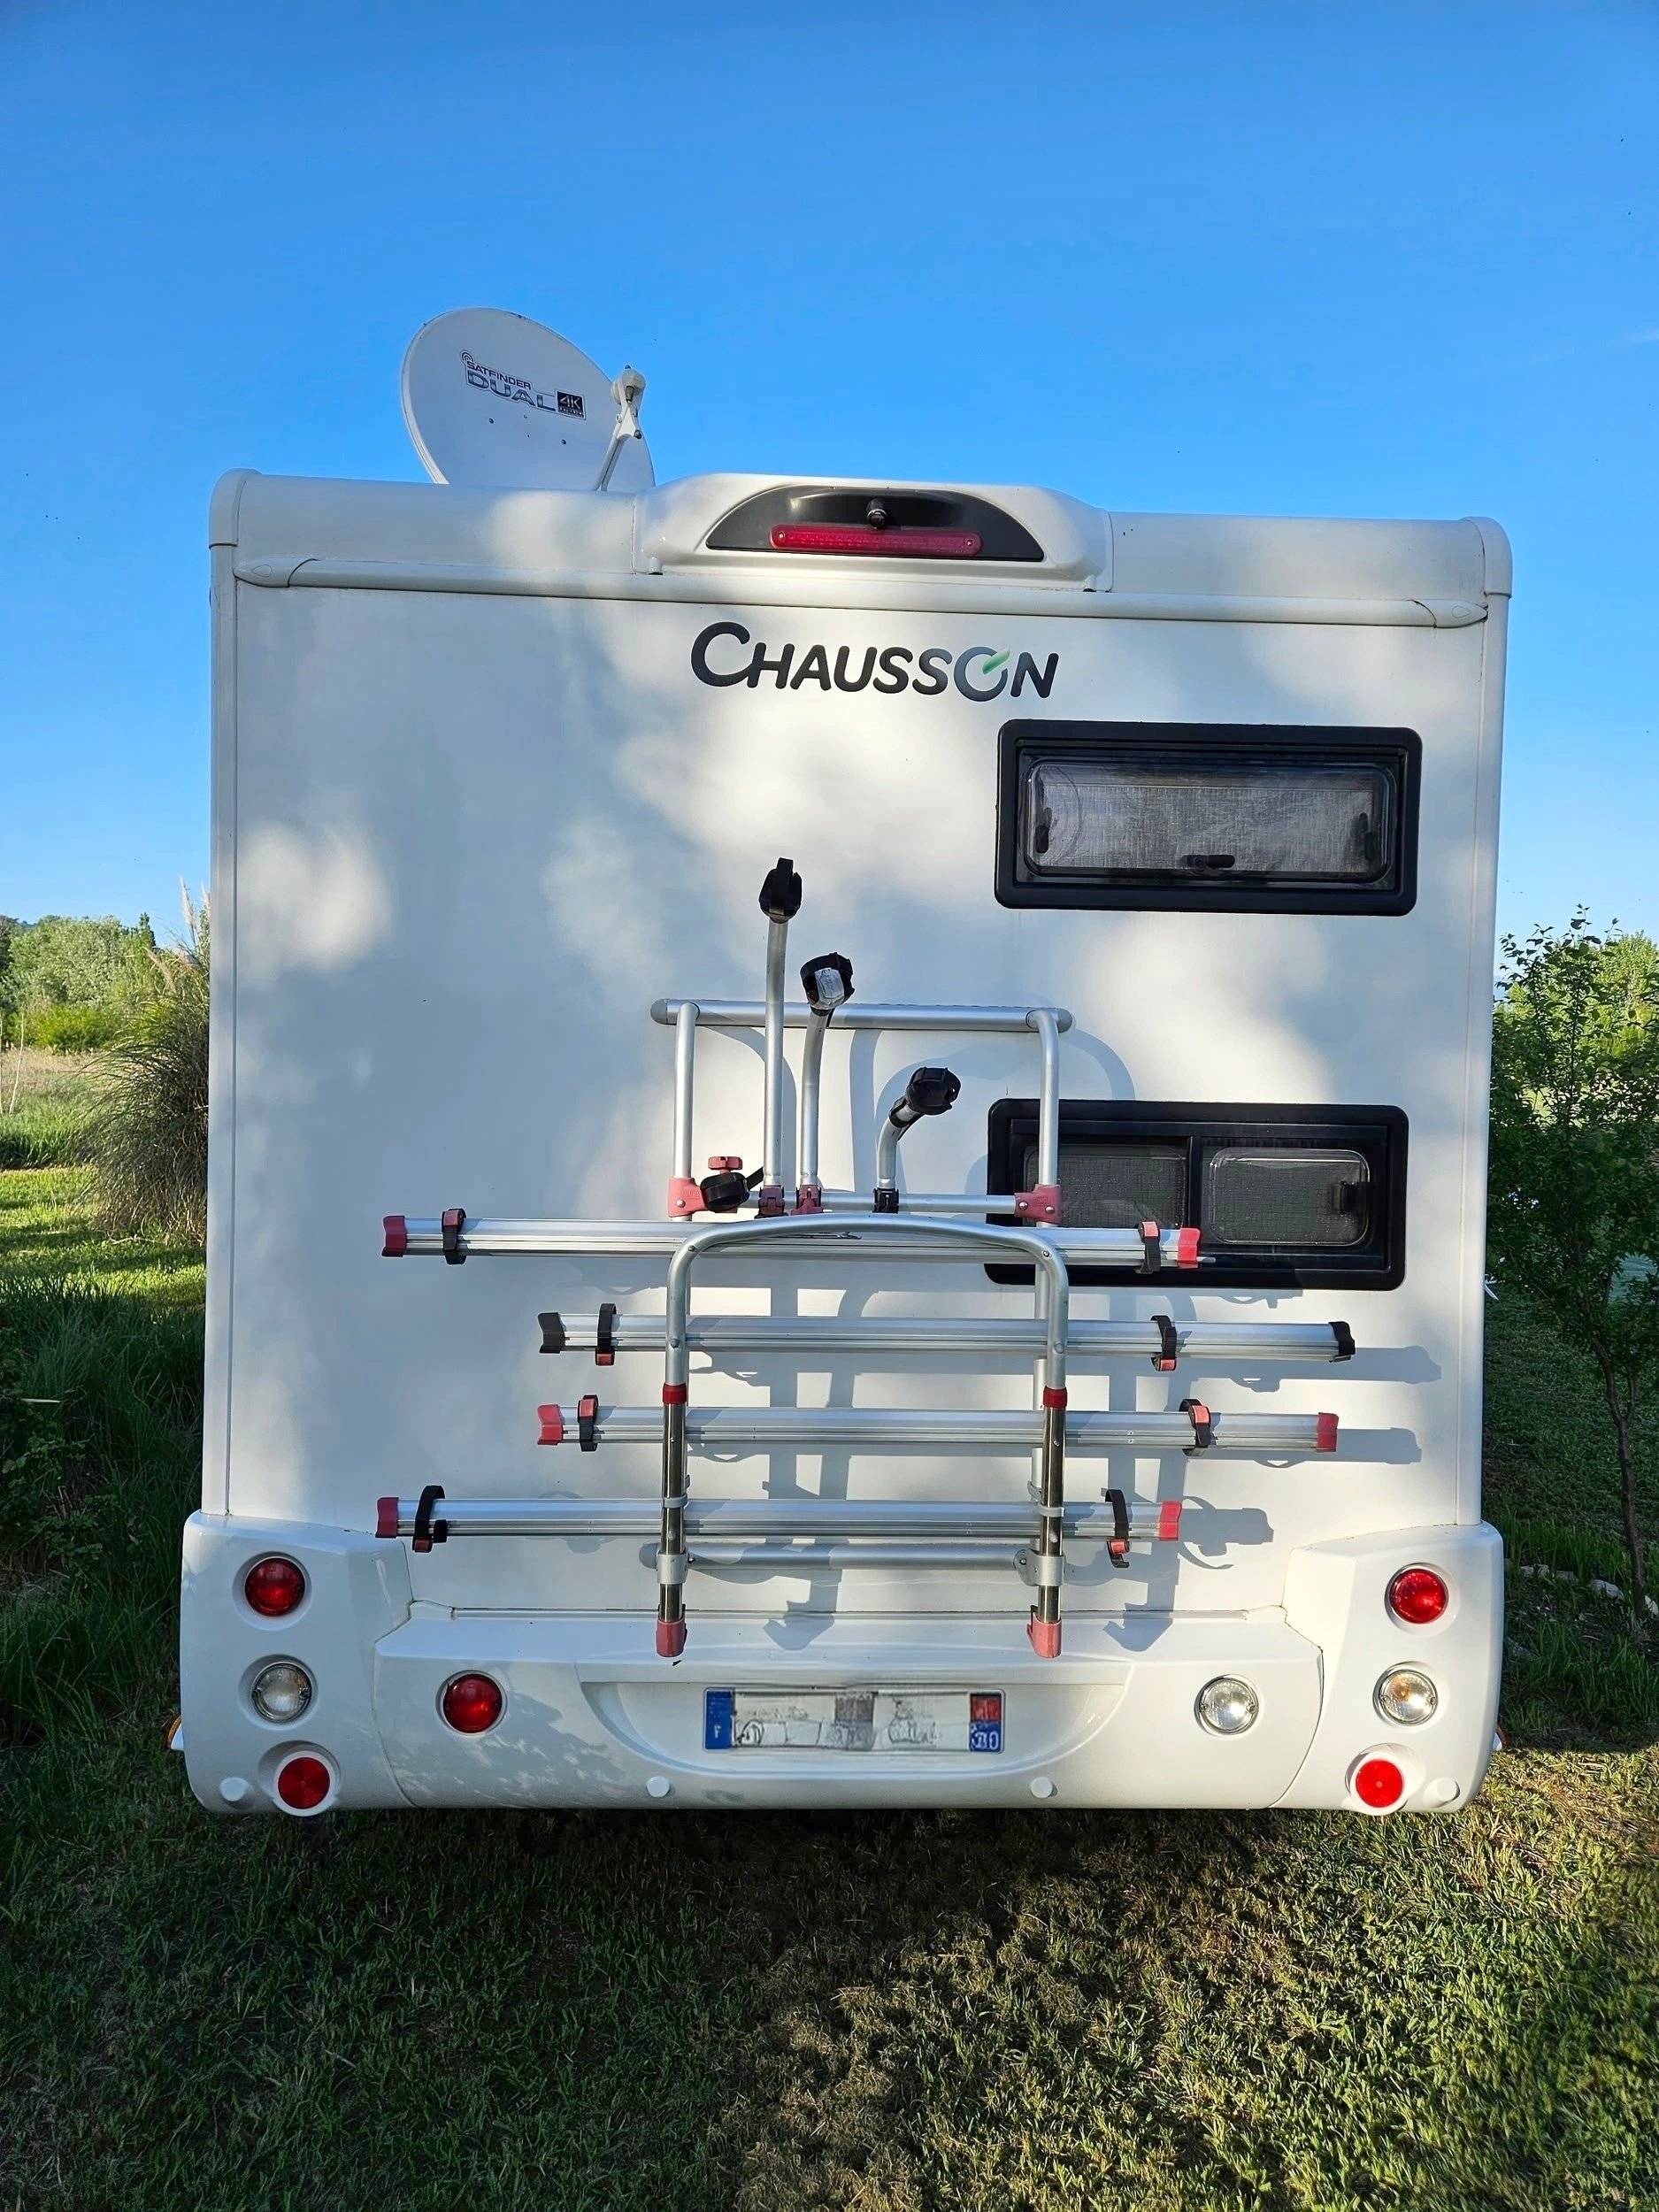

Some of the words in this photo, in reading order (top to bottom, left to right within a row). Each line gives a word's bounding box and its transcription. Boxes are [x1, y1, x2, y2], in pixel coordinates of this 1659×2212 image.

[467, 361, 532, 390] SATFINDER
[467, 370, 557, 412] DUAL
[560, 395, 581, 410] 4K
[691, 621, 1060, 703] CHAUSSON
